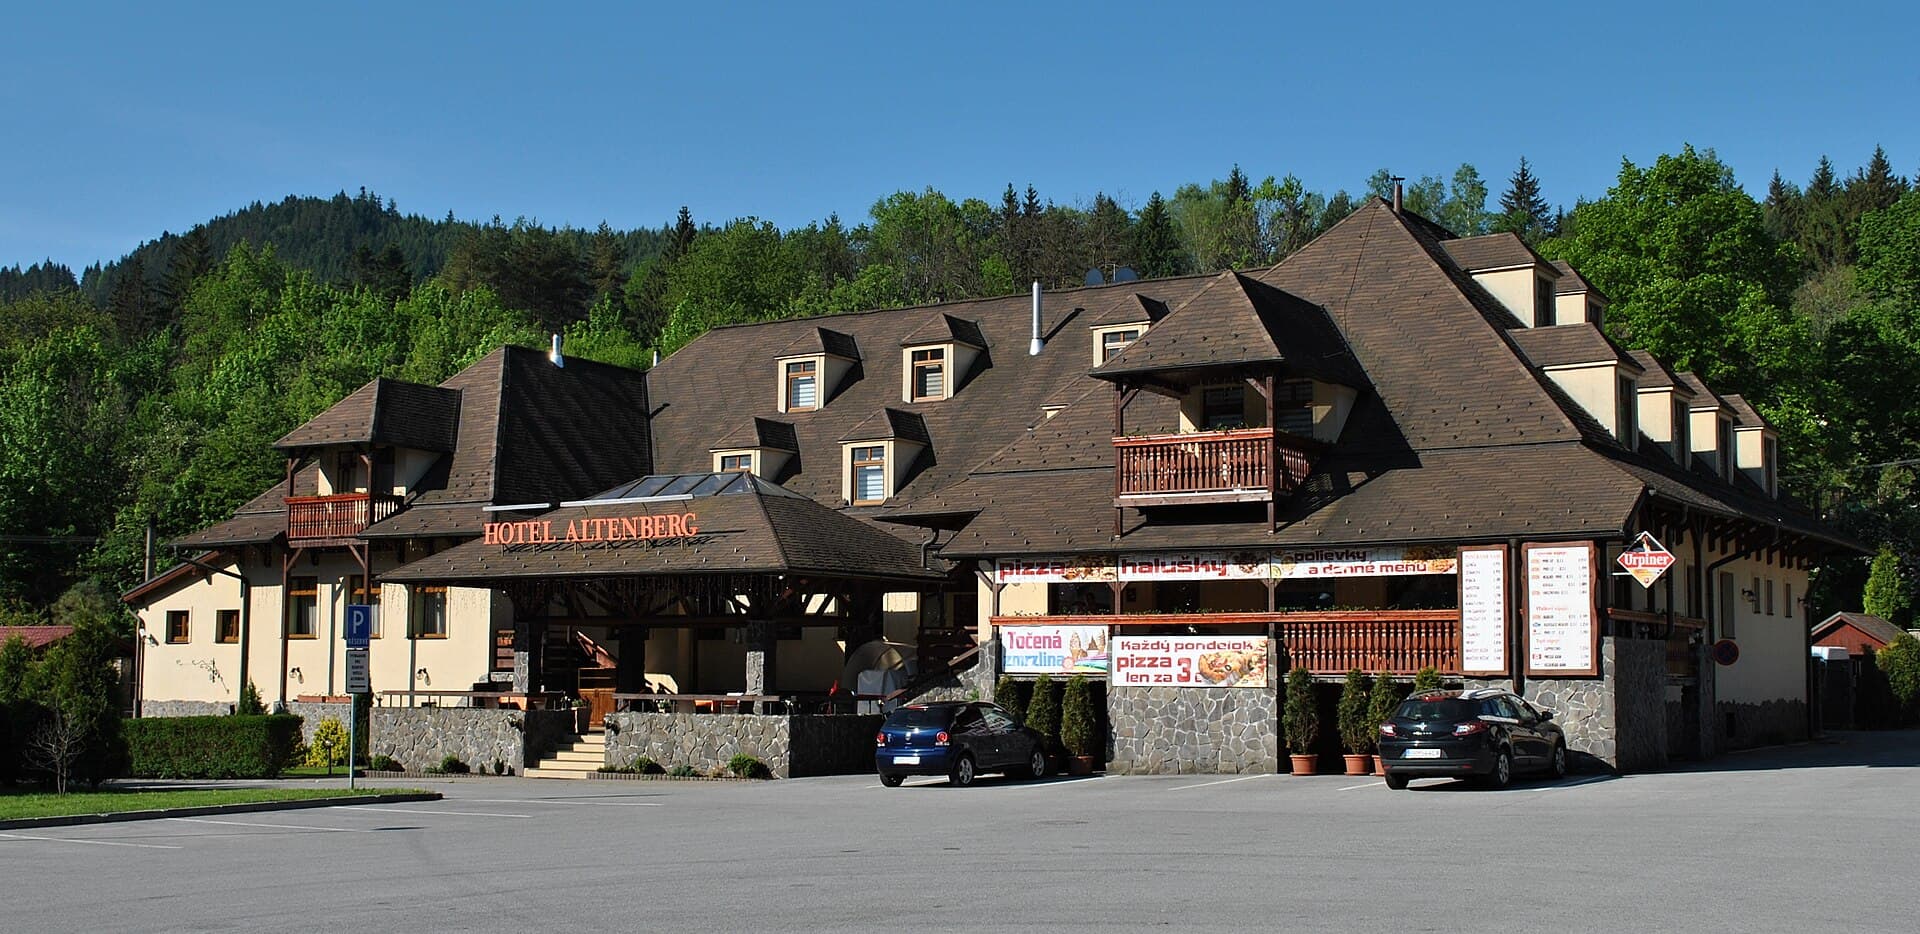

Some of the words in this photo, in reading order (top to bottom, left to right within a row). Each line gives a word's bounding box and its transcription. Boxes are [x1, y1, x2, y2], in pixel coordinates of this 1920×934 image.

[484, 520, 557, 545] HOTEL
[566, 512, 698, 542] ALTENBERG
[1294, 551, 1367, 562] polievky
[1624, 553, 1670, 569] Urpiner
[999, 559, 1066, 580] pizza
[1121, 556, 1227, 577] halušky
[1308, 566, 1318, 575] a
[353, 610, 364, 634] P
[1007, 630, 1062, 649] Točená
[1121, 639, 1171, 653] Každý
[1004, 653, 1065, 668] zmrzlina
[1116, 653, 1173, 672] pizza
[1126, 672, 1150, 683] len
[1154, 673, 1173, 683] za
[1177, 657, 1191, 683] 3
